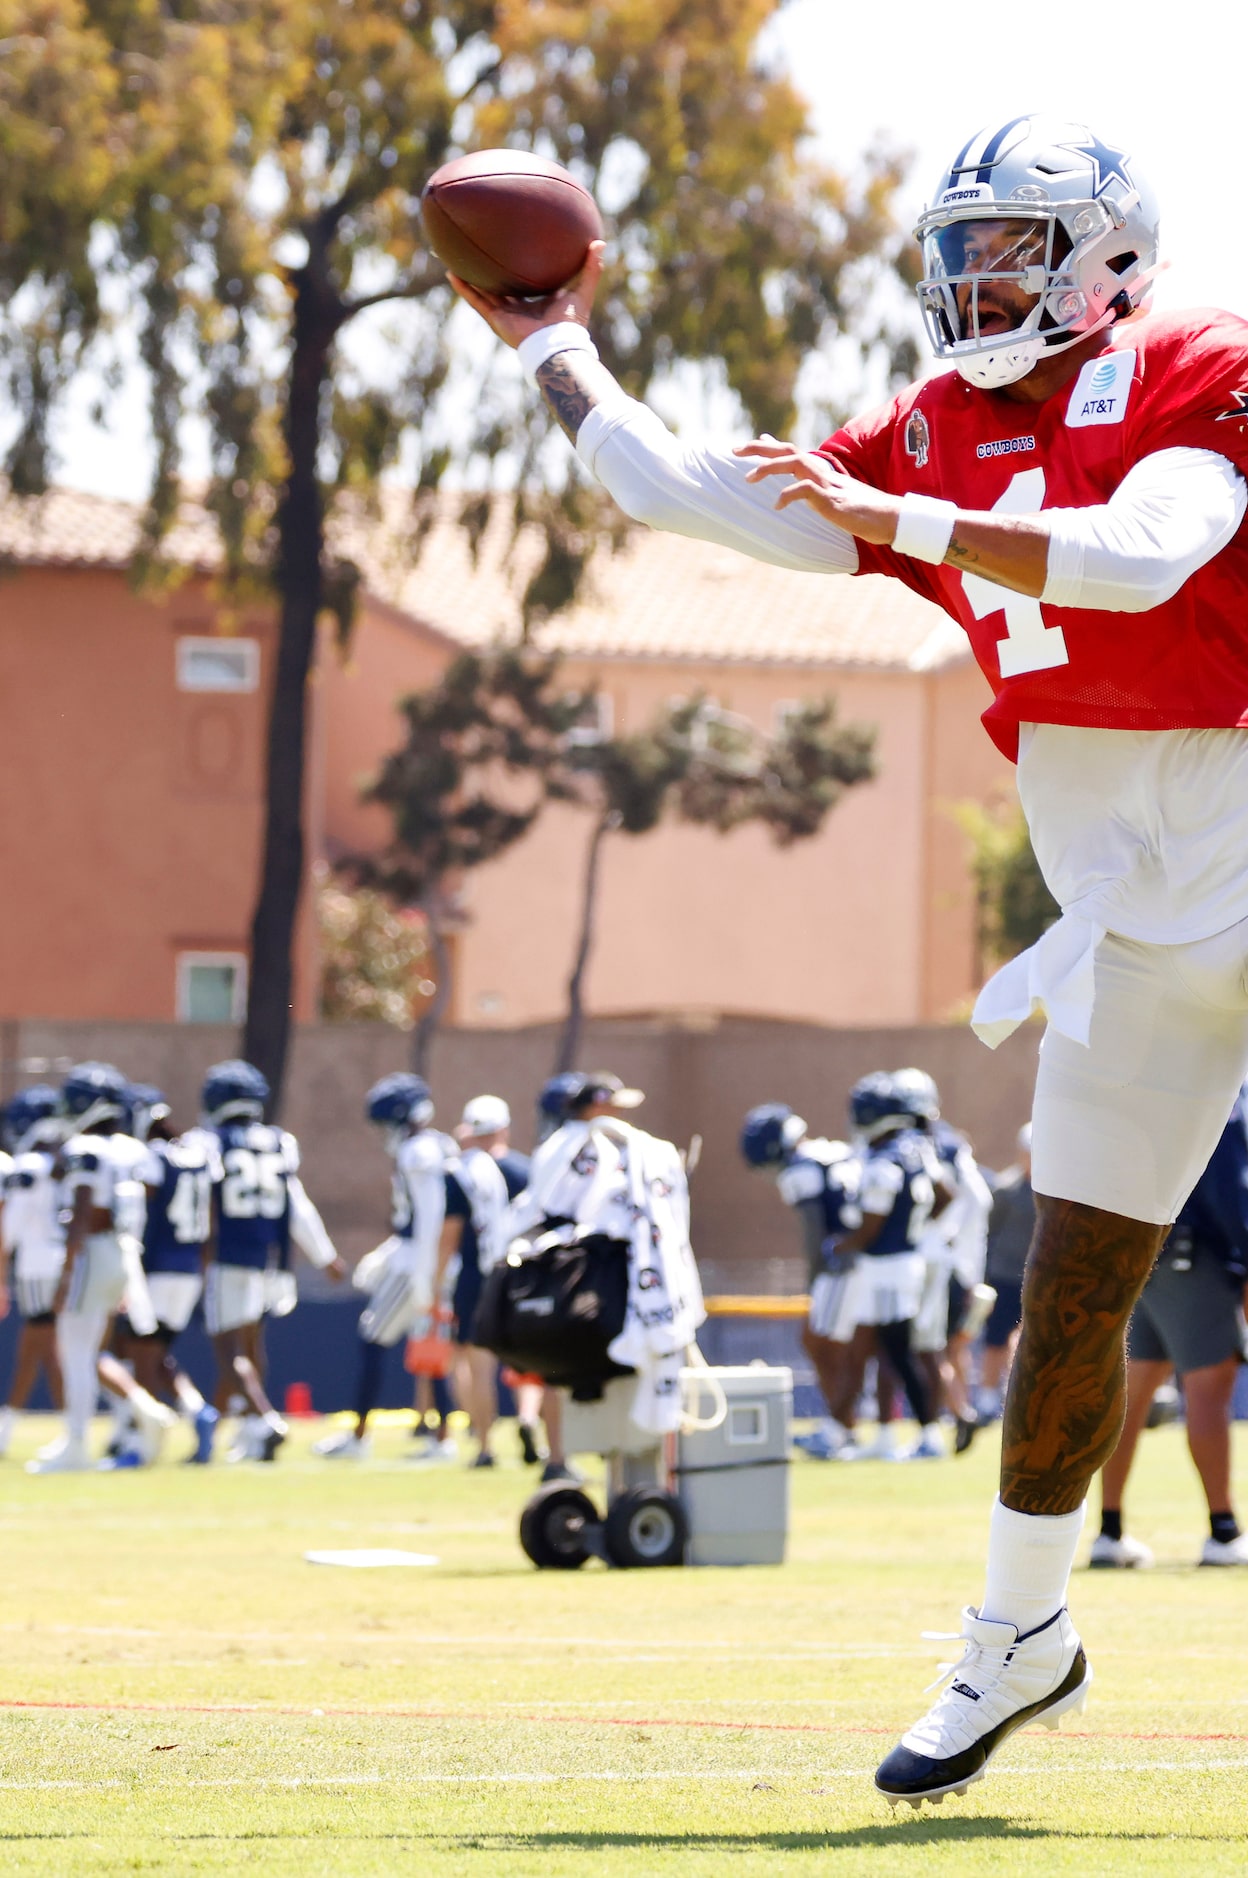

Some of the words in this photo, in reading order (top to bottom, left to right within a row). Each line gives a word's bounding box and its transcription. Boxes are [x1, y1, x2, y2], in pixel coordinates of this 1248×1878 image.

[943, 189, 981, 204] COWBOYS
[1081, 399, 1117, 417] AT&T
[977, 435, 1036, 459] COWBOYS
[961, 467, 1069, 679] 4
[222, 1149, 287, 1219] 25
